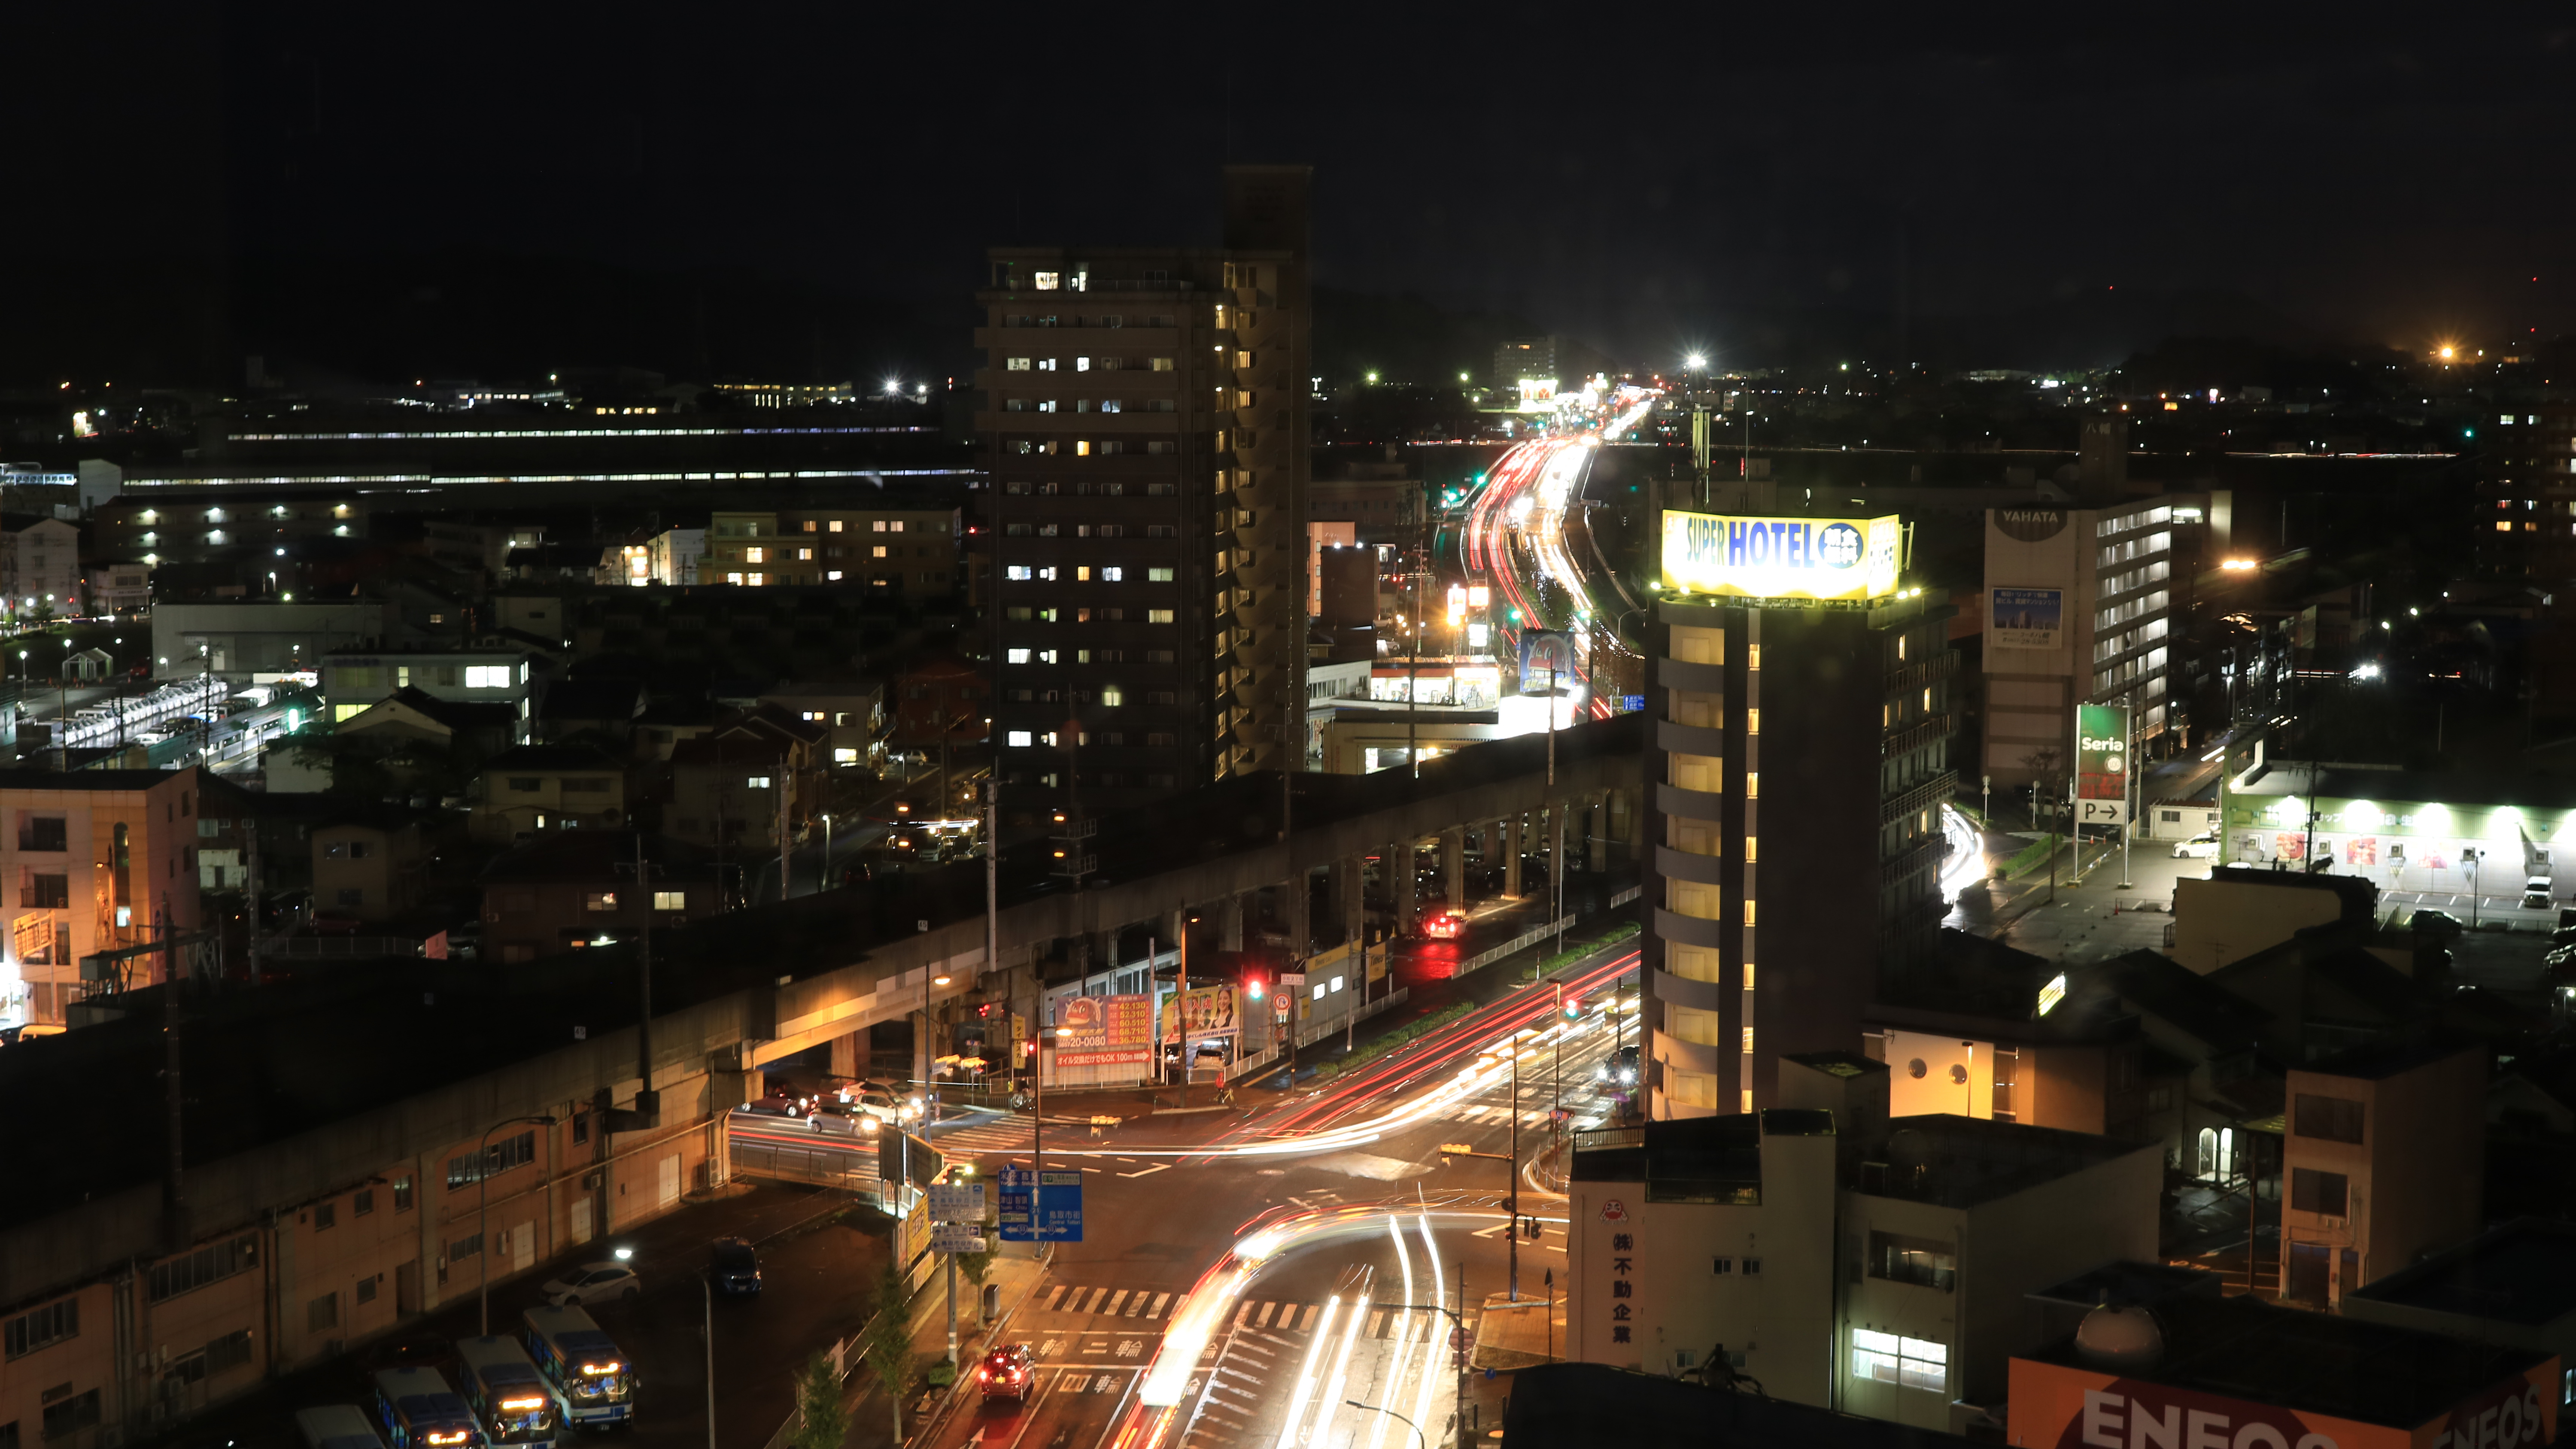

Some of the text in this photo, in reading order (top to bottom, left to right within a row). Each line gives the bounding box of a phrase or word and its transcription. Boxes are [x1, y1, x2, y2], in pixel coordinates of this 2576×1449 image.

[2003, 510, 2058, 522] YAHATA
[1687, 516, 1725, 565] SUPER
[1729, 522, 1815, 568] HOTEL
[2082, 736, 2124, 751] Seria
[2085, 802, 2096, 819] P
[1370, 954, 1383, 967] Times
[1070, 1036, 1106, 1047] 20-0080
[1057, 1053, 1115, 1065] オイル交換だけでもOK
[1049, 1211, 1081, 1219] 鳥取市街
